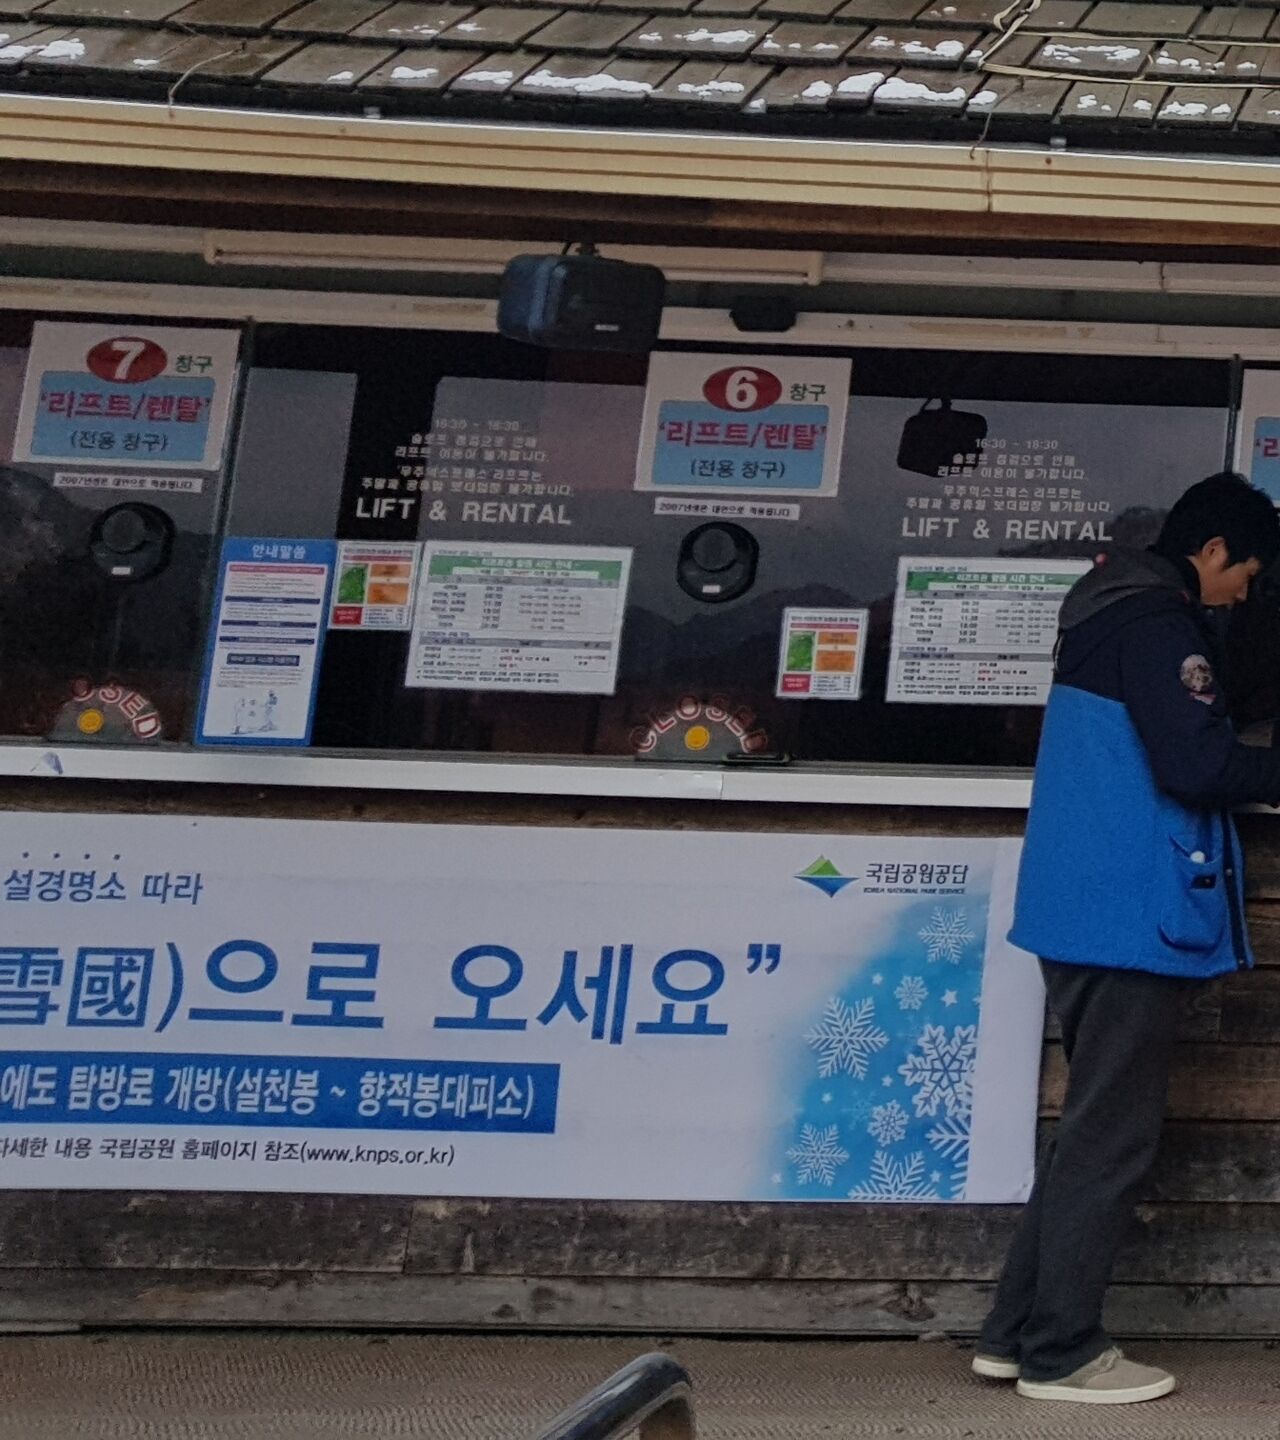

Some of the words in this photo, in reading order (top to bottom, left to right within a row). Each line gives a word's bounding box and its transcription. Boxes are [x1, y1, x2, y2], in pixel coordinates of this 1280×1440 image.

[111, 341, 145, 380] 7
[175, 355, 213, 373] 창구
[725, 369, 759, 409] 6
[790, 383, 826, 402] 창구
[70, 430, 115, 451] (전용
[122, 432, 169, 452] 창구)
[691, 460, 734, 478] (전용
[742, 461, 786, 479] 창구)
[356, 497, 416, 519] LIFT
[429, 499, 447, 521] &
[462, 501, 572, 525] RENTAL
[902, 517, 959, 538] LIFT
[973, 519, 990, 539] &
[1005, 519, 1113, 541] RENTAL
[252, 544, 306, 560] 안내말씀
[866, 863, 969, 884] 국립공원공단
[4, 869, 127, 903] 설경명소
[142, 872, 204, 905] 따라
[0, 1064, 58, 1111] 에도
[68, 1064, 154, 1111] 탐방로
[165, 1065, 319, 1116] 개방(설천봉
[358, 1071, 533, 1119] 향적봉대피소)
[55, 1137, 92, 1159] 내용
[99, 1138, 176, 1160] 국립공원
[181, 1139, 256, 1160] 홈페이지
[264, 1140, 455, 1166] 참조(www.knps.or.kr)
